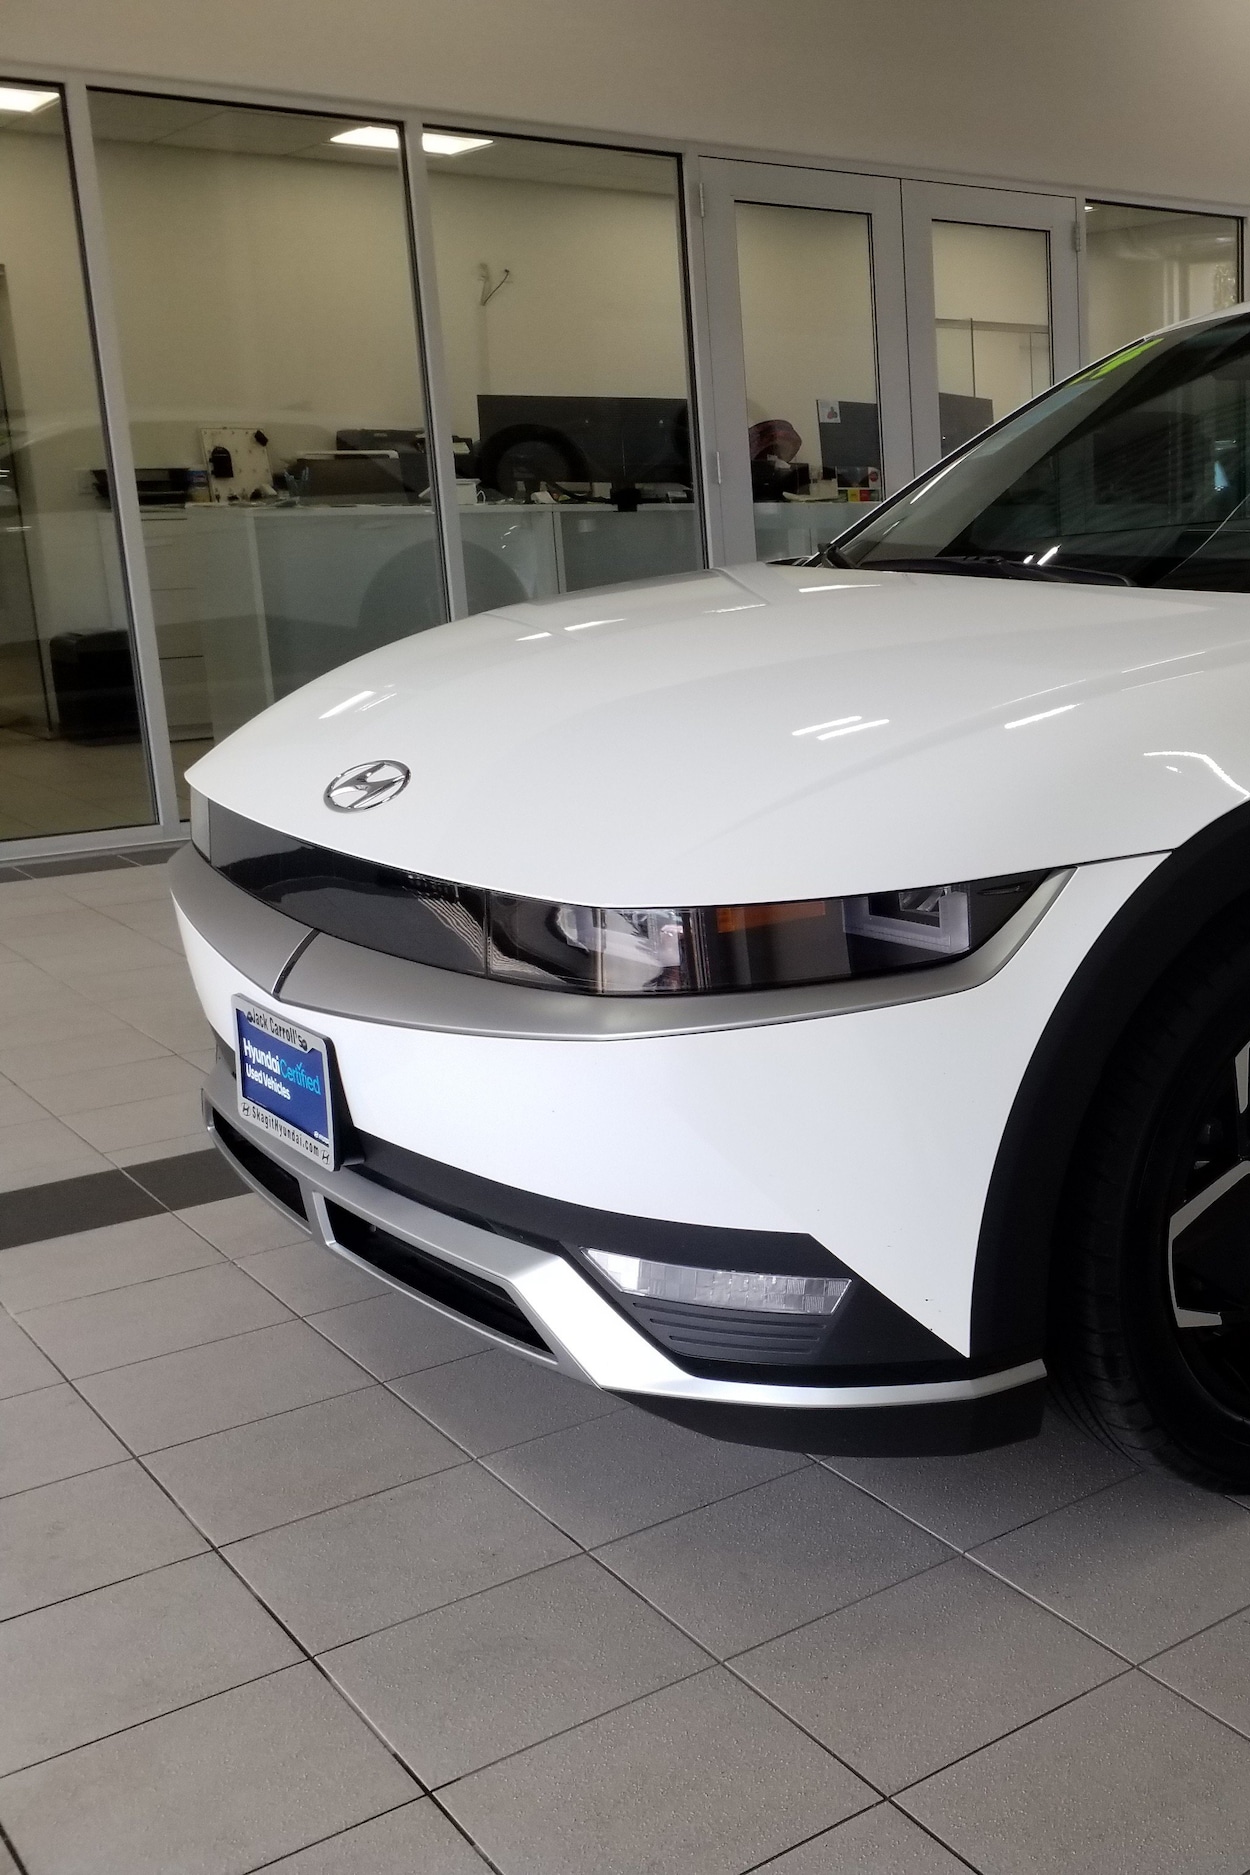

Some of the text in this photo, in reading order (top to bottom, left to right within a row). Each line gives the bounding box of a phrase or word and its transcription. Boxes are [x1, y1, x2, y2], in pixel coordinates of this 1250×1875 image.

[252, 1007, 303, 1049] Jack Carroll's
[242, 1037, 321, 1095] Hyundai Certified
[245, 1062, 291, 1100] Used Vehicles
[252, 1106, 320, 1157] SkagitHyundai.com
